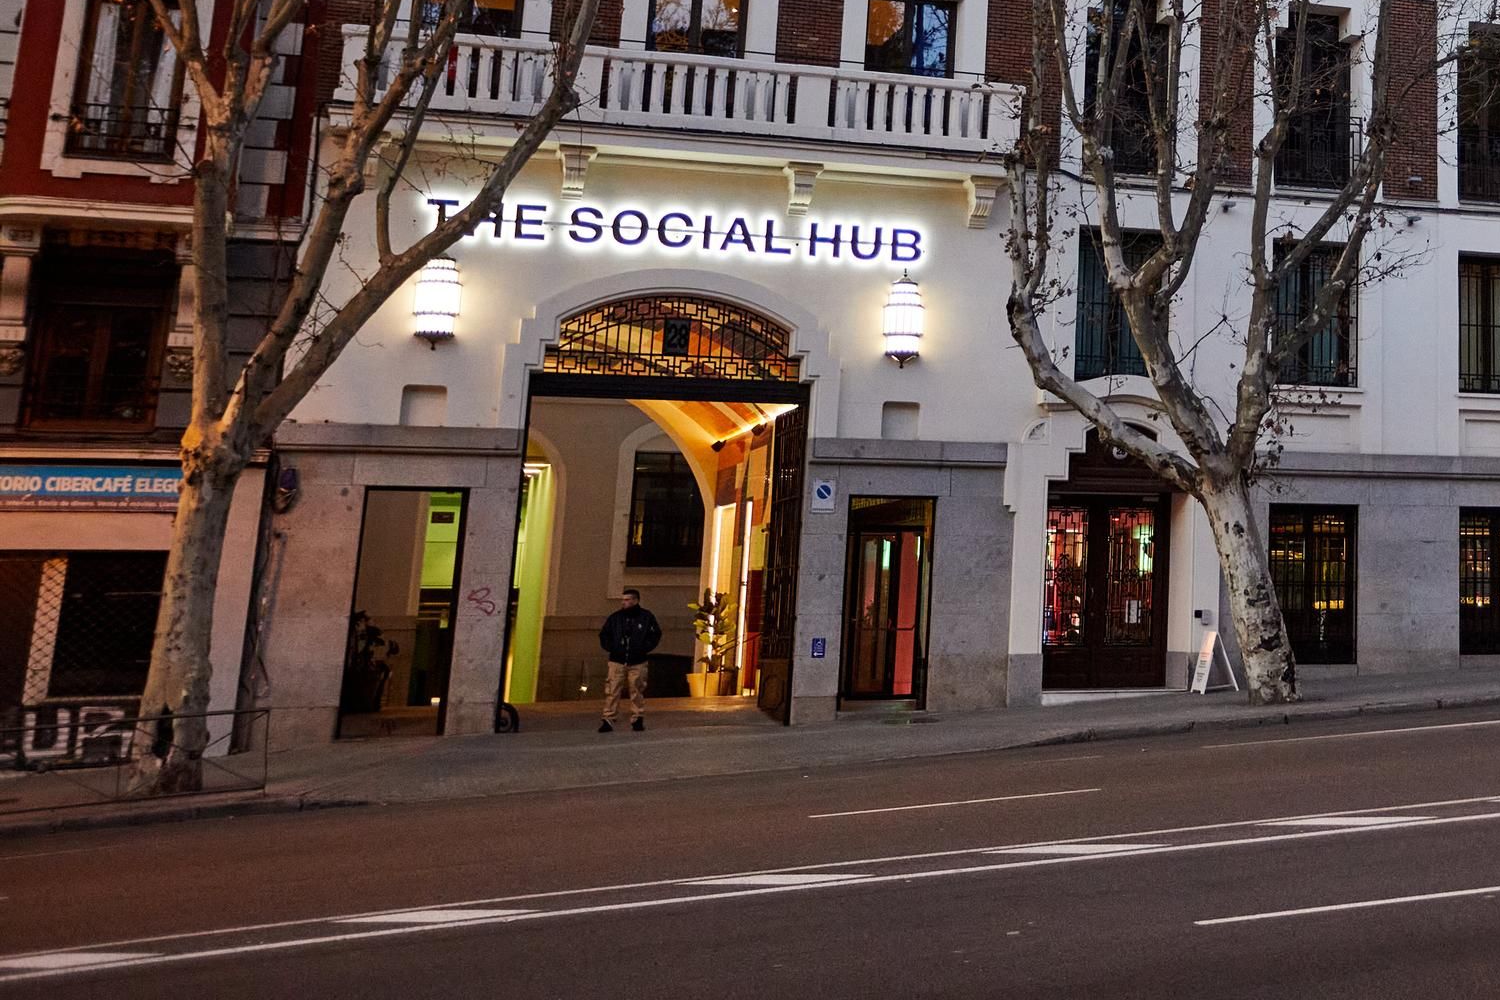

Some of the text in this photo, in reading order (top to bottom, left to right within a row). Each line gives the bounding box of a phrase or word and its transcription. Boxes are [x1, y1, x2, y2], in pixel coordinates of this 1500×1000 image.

[568, 206, 792, 255] SOCIAL
[808, 222, 922, 262] HUB
[667, 323, 689, 349] 28
[45, 475, 132, 493] CIBERCAFÉ
